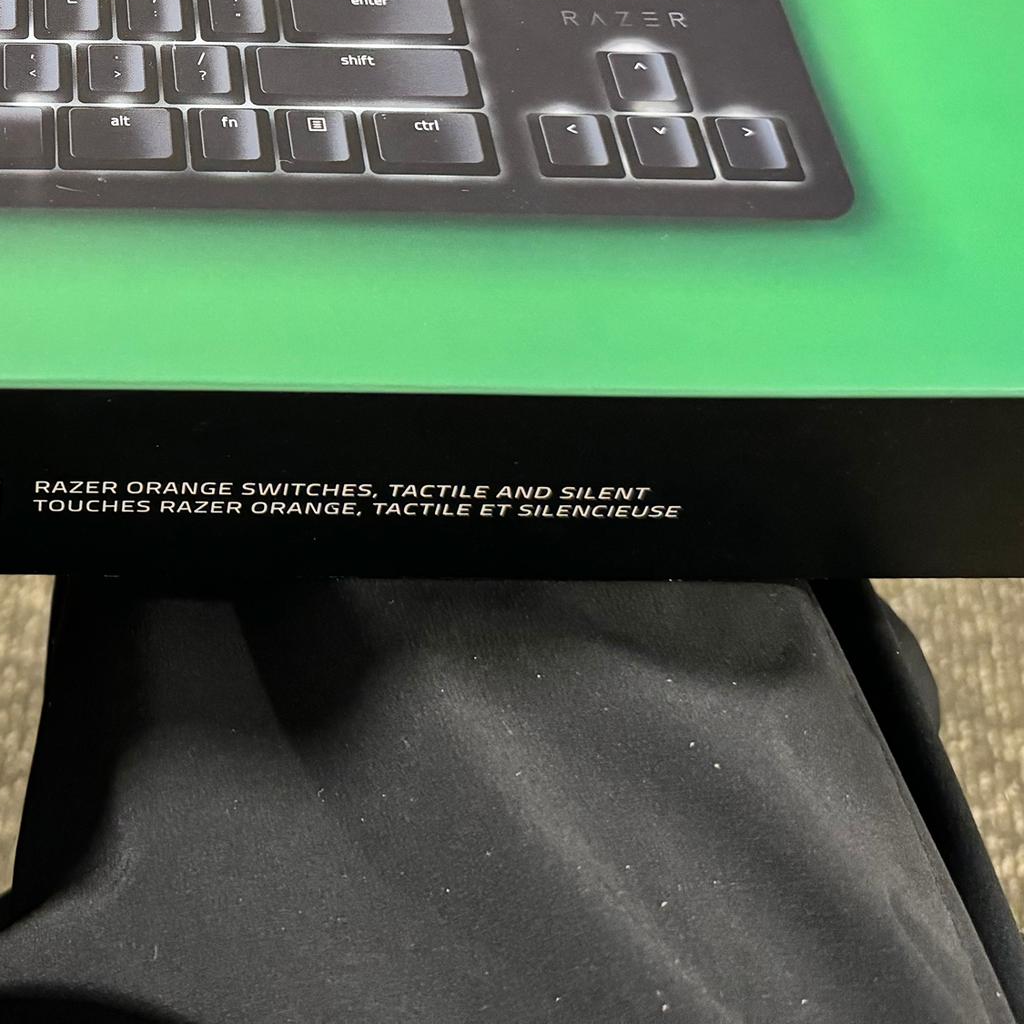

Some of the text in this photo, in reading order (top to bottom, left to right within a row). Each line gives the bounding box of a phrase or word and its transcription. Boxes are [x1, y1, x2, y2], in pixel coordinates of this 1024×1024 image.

[561, 10, 688, 28] RAZER
[340, 54, 376, 66] shift
[110, 115, 131, 127] alt
[222, 116, 238, 128] fn
[414, 119, 439, 131] ctrl
[34, 480, 650, 501] RAZER ORANGE SWITCHES, TACTILE AND SILENT
[33, 499, 682, 519] TOUCHES RAZER ORANGE, TACTILE ET SILENCIEUSE
